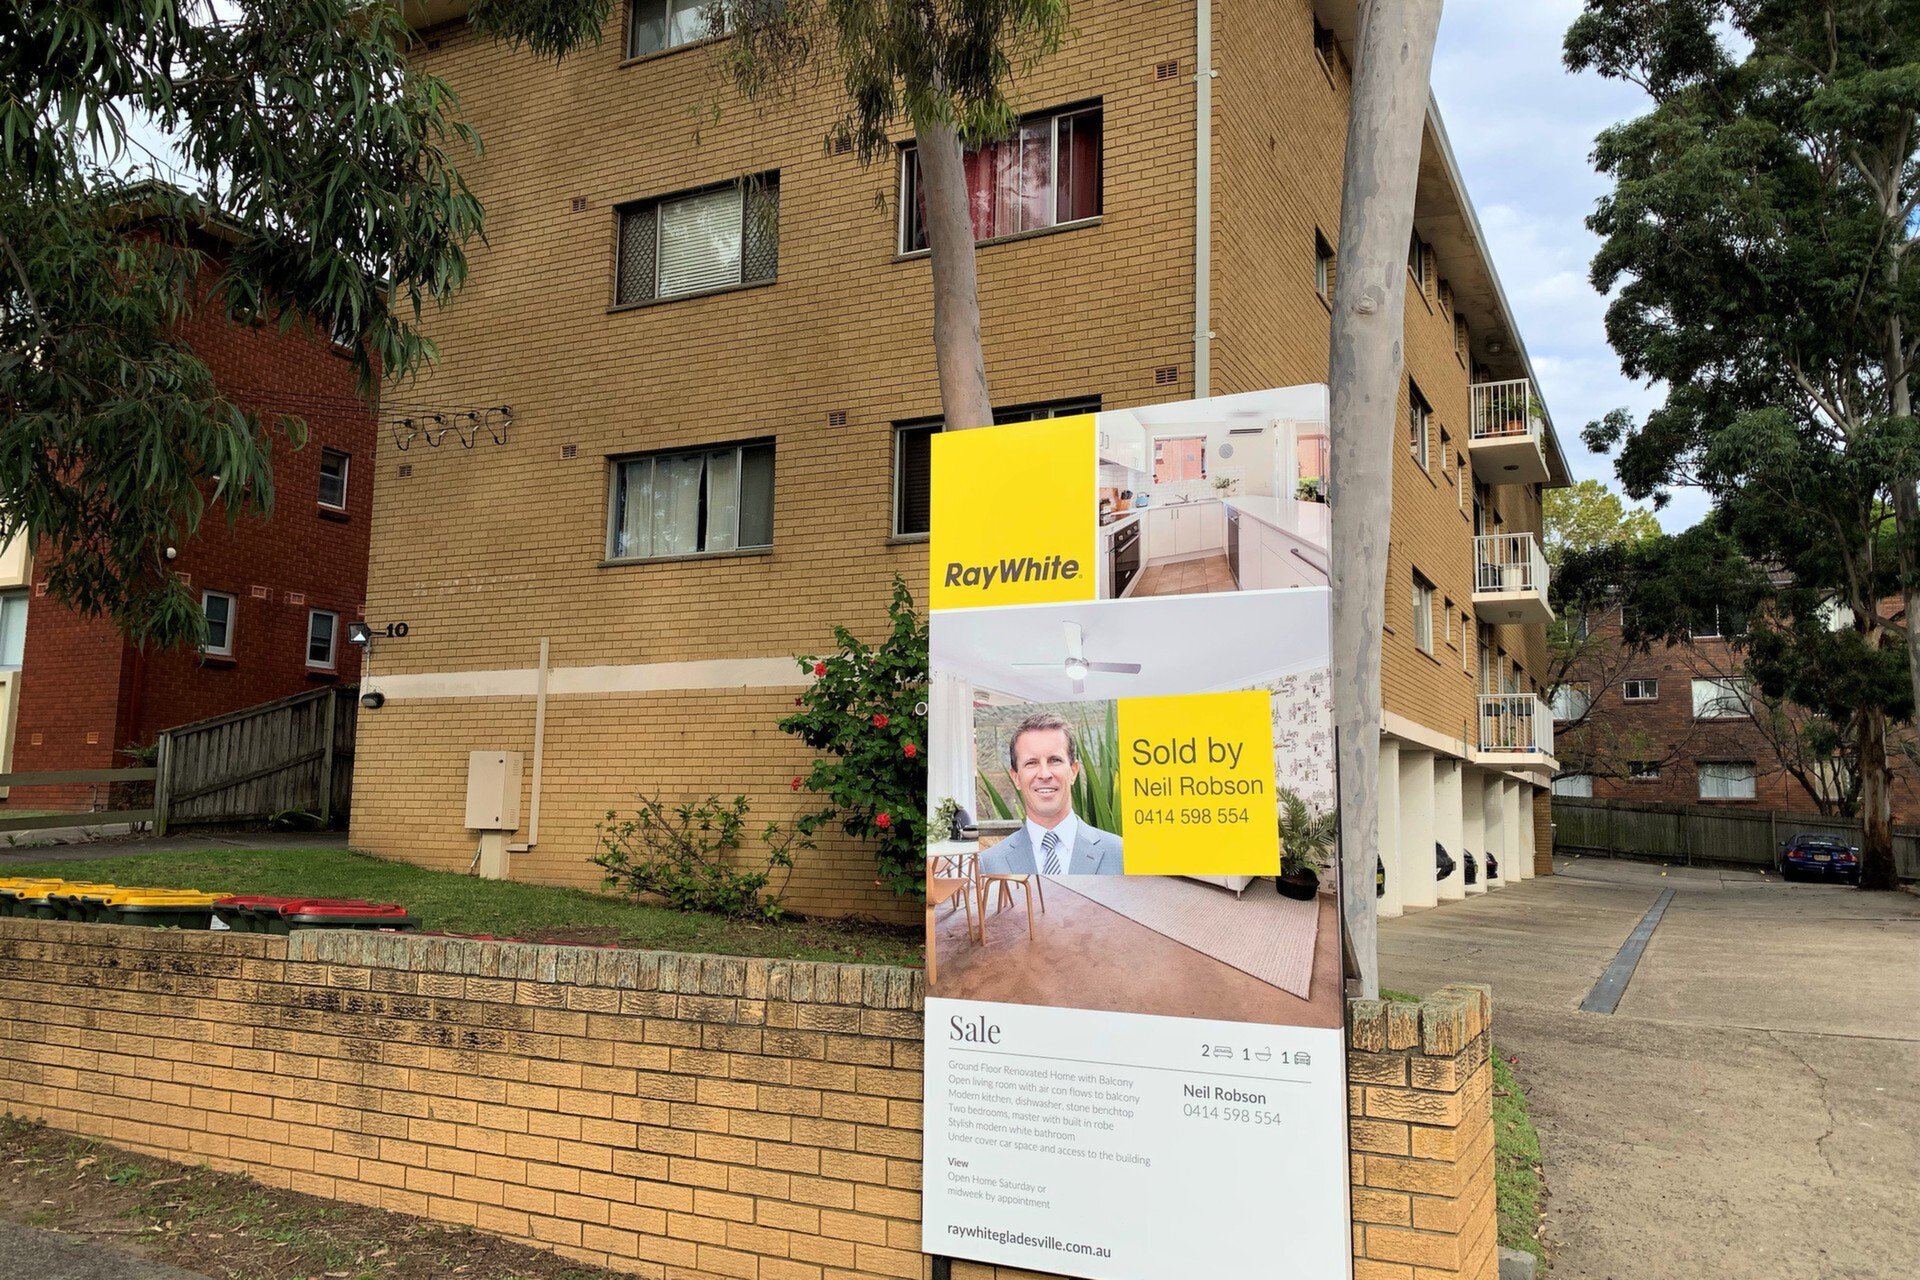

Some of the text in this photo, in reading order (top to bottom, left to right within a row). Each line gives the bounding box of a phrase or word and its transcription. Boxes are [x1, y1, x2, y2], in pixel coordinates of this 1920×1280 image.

[945, 555, 1079, 590] RayWhite
[386, 622, 409, 638] 10
[1132, 736, 1243, 770] Sold by
[1134, 776, 1263, 797] Neil Robson
[1134, 807, 1249, 825] 0414 598 554
[950, 1015, 1001, 1044] Sale
[1201, 1043, 1290, 1064] 2 1 1
[948, 1060, 1134, 1088] Ground Floor Renovated Home with Balcony
[948, 1074, 1140, 1104] Open living room with air con flows to balcony
[1184, 1084, 1266, 1104] Neil Robson
[948, 1089, 980, 1100] Modern
[1066, 1102, 1090, 1113] stone
[1092, 1104, 1134, 1118] benchtop
[1183, 1103, 1282, 1125] 0414 598 554
[948, 1102, 966, 1113] Two
[1012, 1112, 1040, 1121] master
[1042, 1114, 1061, 1124] with
[1062, 1116, 1082, 1128] built
[1083, 1118, 1092, 1127] in
[1093, 1120, 1114, 1130] robe
[948, 1117, 1075, 1141] Stylish modern white bathroom
[948, 1132, 1151, 1167] Under cover car space and access to the building
[947, 1157, 969, 1168] View
[947, 1171, 1047, 1193] Open Home Saturday or
[947, 1186, 1050, 1209] midweek by appointment
[948, 1225, 1111, 1258] raywhitegladesville.com.au
